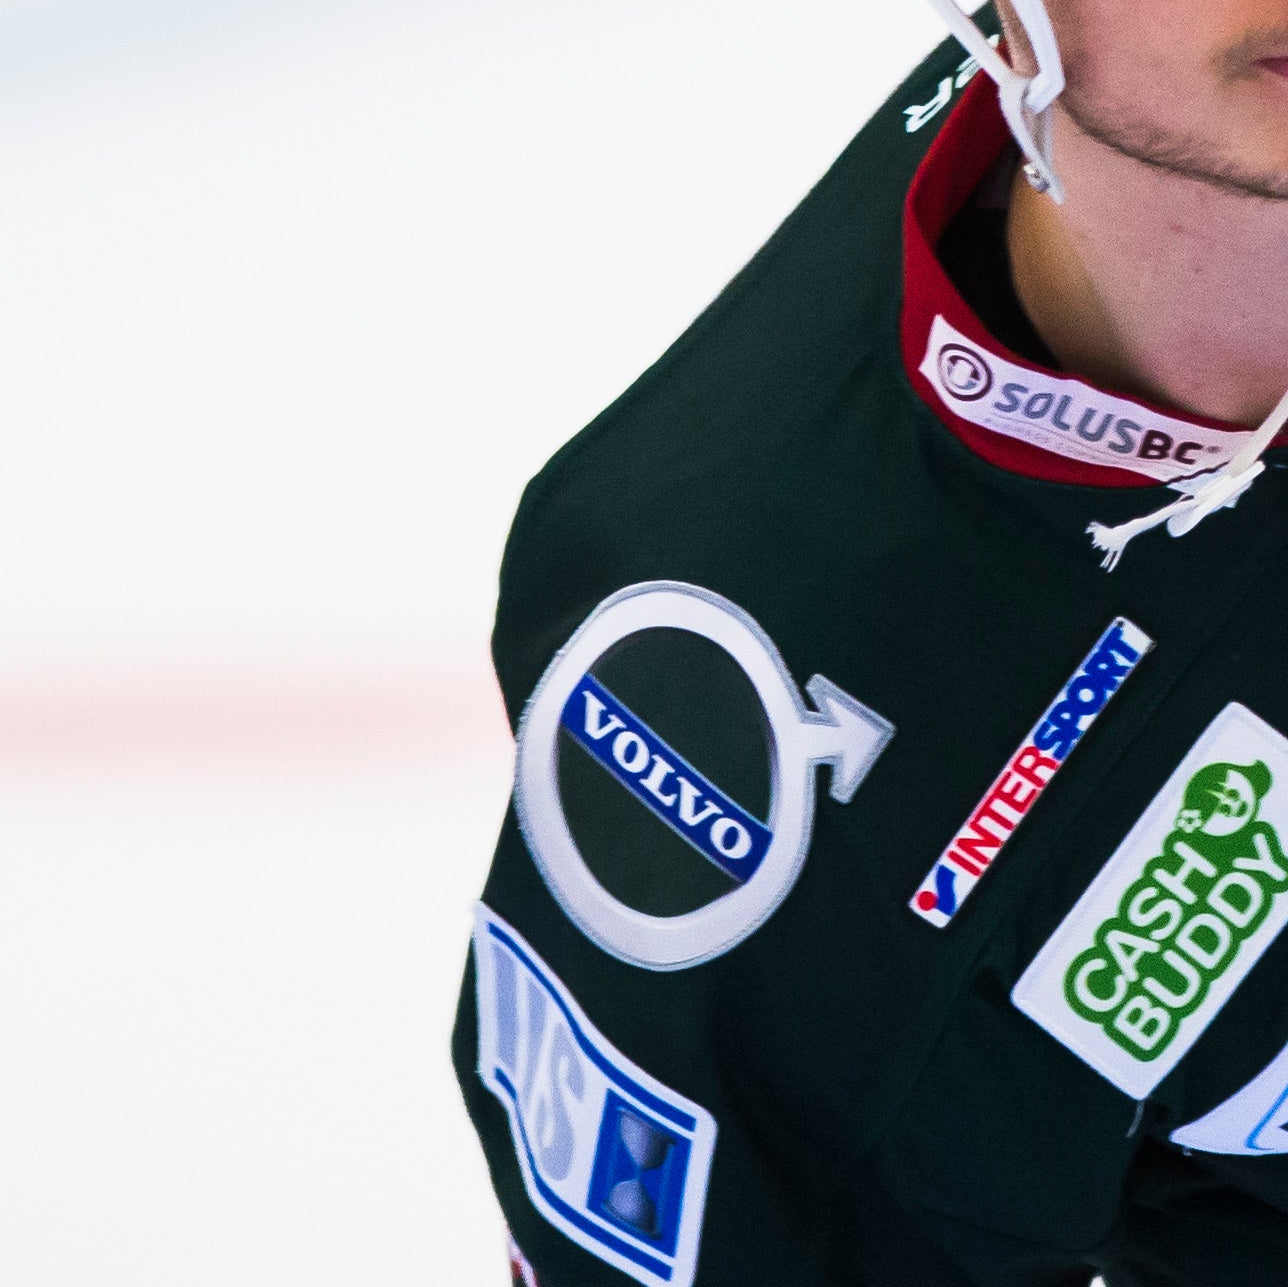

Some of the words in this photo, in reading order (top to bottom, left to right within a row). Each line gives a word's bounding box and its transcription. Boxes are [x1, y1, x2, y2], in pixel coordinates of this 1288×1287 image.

[581, 690, 753, 862] VOLVO
[948, 623, 1143, 876] INTERSPORT
[1074, 840, 1218, 1013] CASH
[1113, 832, 1288, 1051] BUDDY
